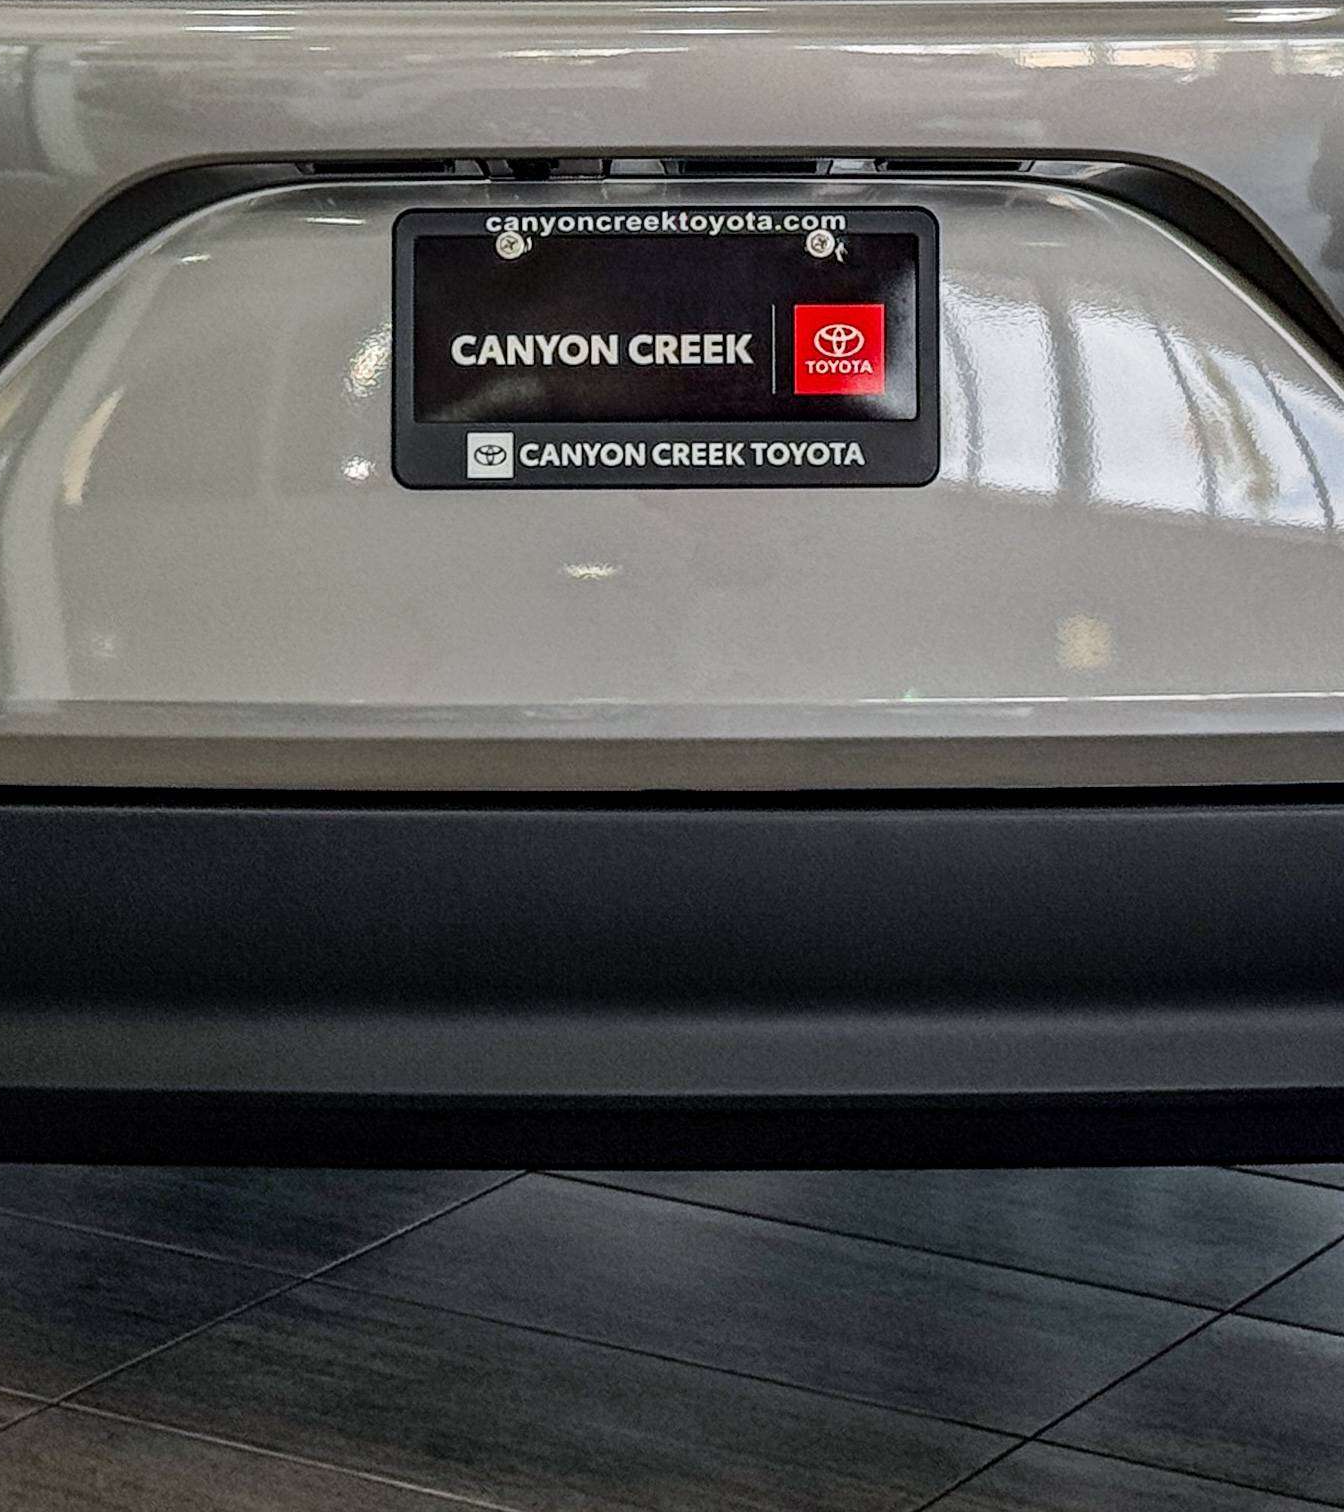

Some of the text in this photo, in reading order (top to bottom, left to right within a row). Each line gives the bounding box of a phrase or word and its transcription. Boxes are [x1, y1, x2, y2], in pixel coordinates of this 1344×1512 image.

[485, 210, 847, 237] canyoncreektoyota.com
[451, 334, 754, 366] CANYON CREEK
[805, 360, 873, 375] TOYOTA
[520, 442, 866, 467] CANYON CREEK TOYOTA
